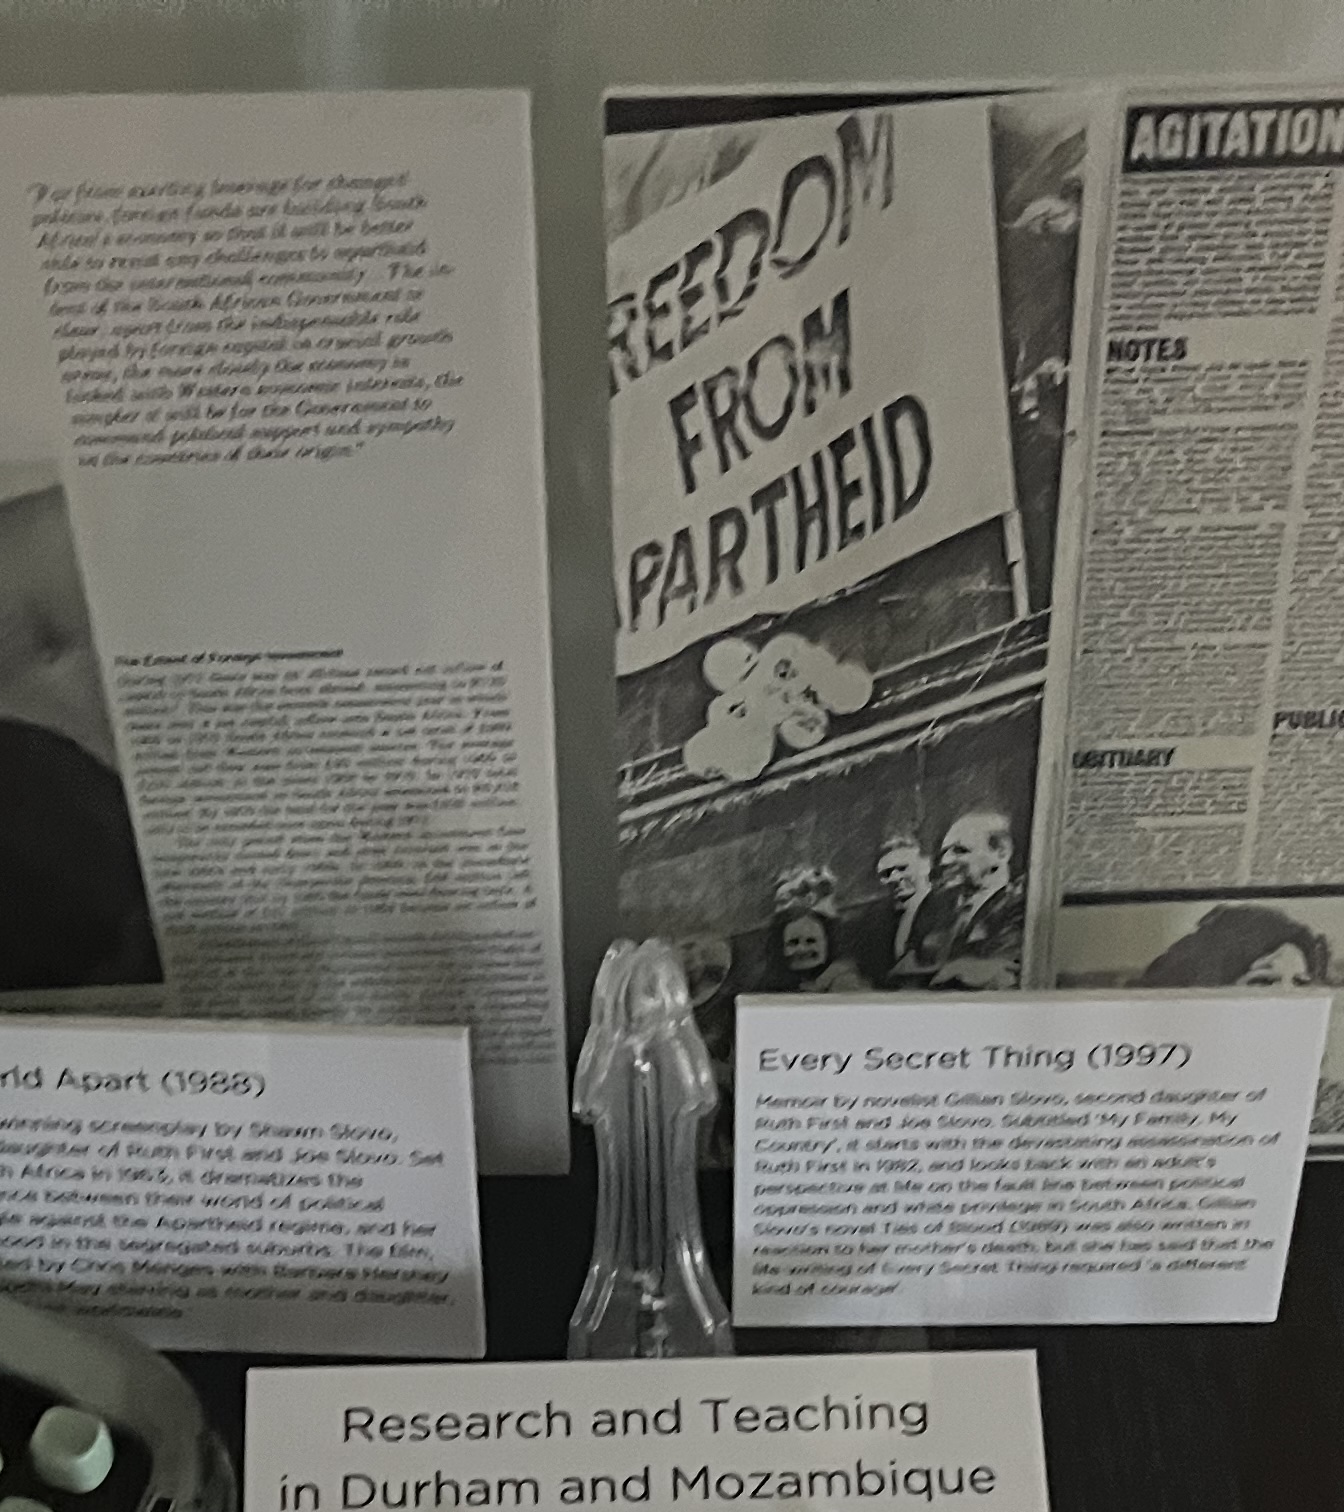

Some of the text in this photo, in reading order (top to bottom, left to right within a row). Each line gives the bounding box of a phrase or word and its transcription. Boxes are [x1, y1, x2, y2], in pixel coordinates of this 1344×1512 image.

[1106, 336, 1188, 362] NOTES
[668, 287, 853, 495] FROM
[628, 394, 932, 633] PARTHEID
[760, 1042, 1193, 1075] Every Secret Thing (1997)
[57, 1067, 150, 1093] Apart
[161, 1069, 266, 1099] (1988)
[834, 1095, 859, 1111] by
[215, 1121, 243, 1140] by
[98, 1141, 120, 1158] of
[343, 1394, 929, 1444] Research and Teaching
[278, 1459, 996, 1512] in Durham and Mozambique
